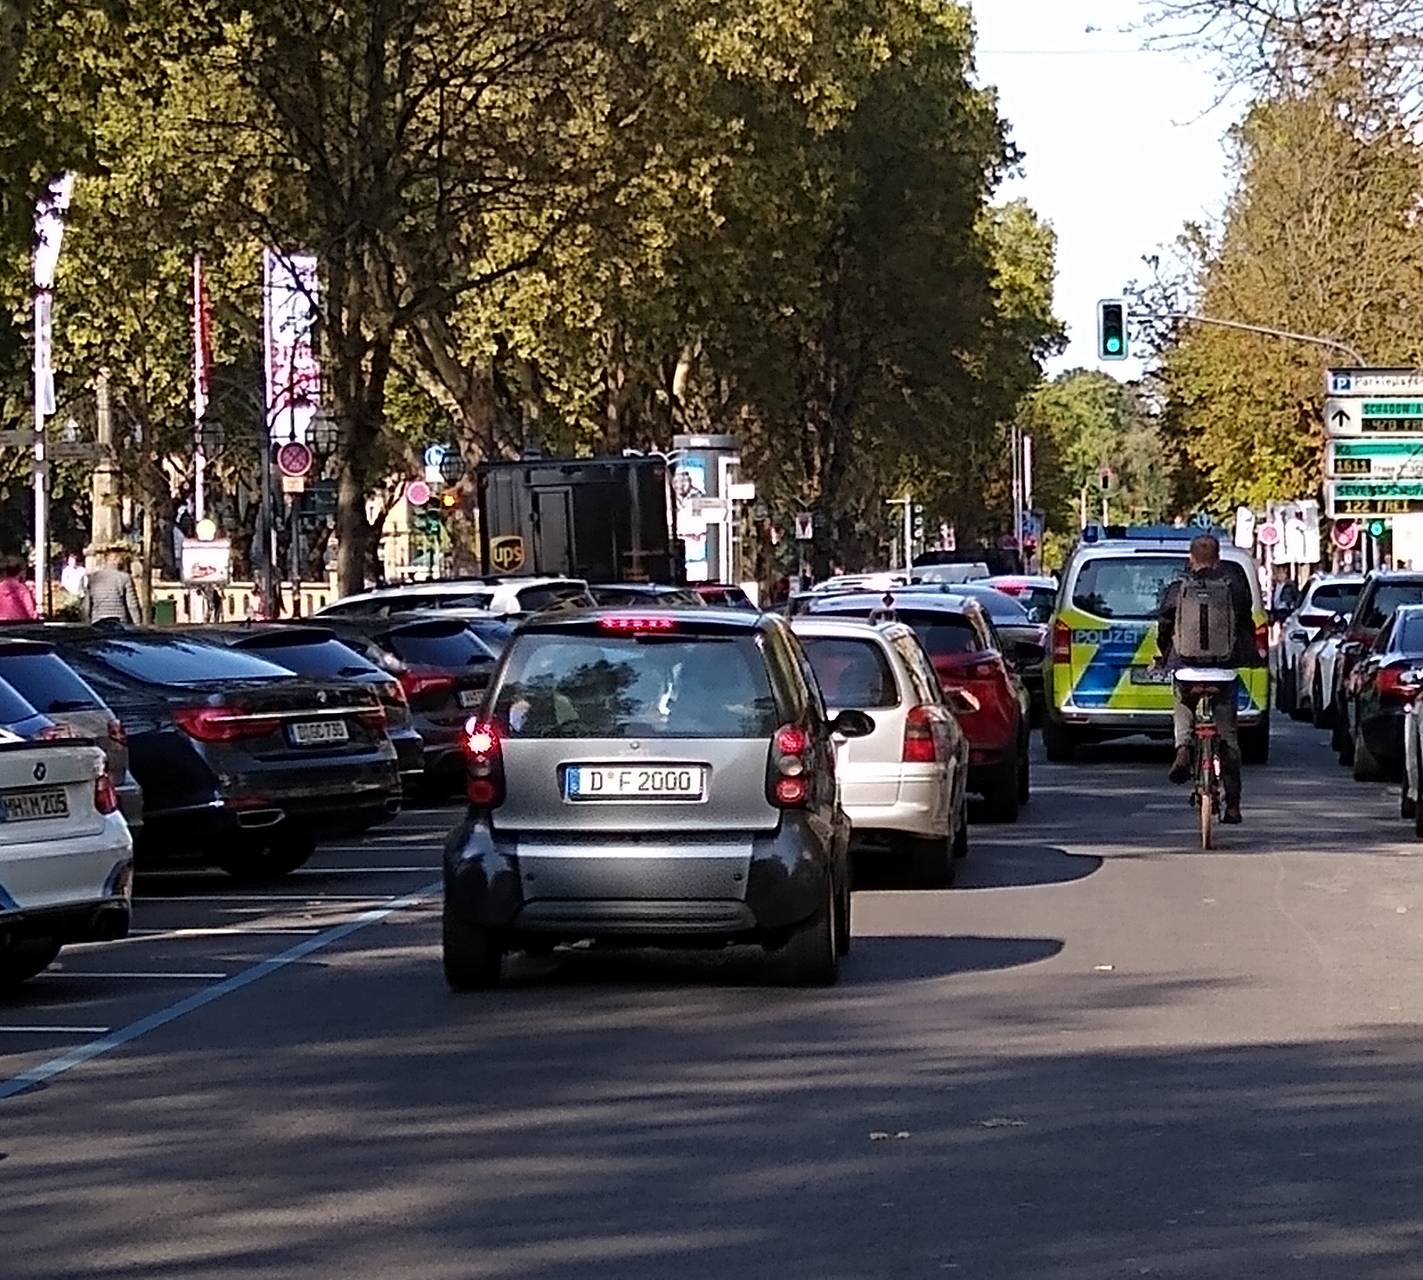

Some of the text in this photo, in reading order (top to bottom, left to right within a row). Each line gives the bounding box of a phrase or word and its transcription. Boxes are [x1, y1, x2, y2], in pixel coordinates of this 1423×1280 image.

[494, 546, 523, 567] ups
[1075, 630, 1138, 644] POLIZEI
[591, 771, 691, 791] D F 2000
